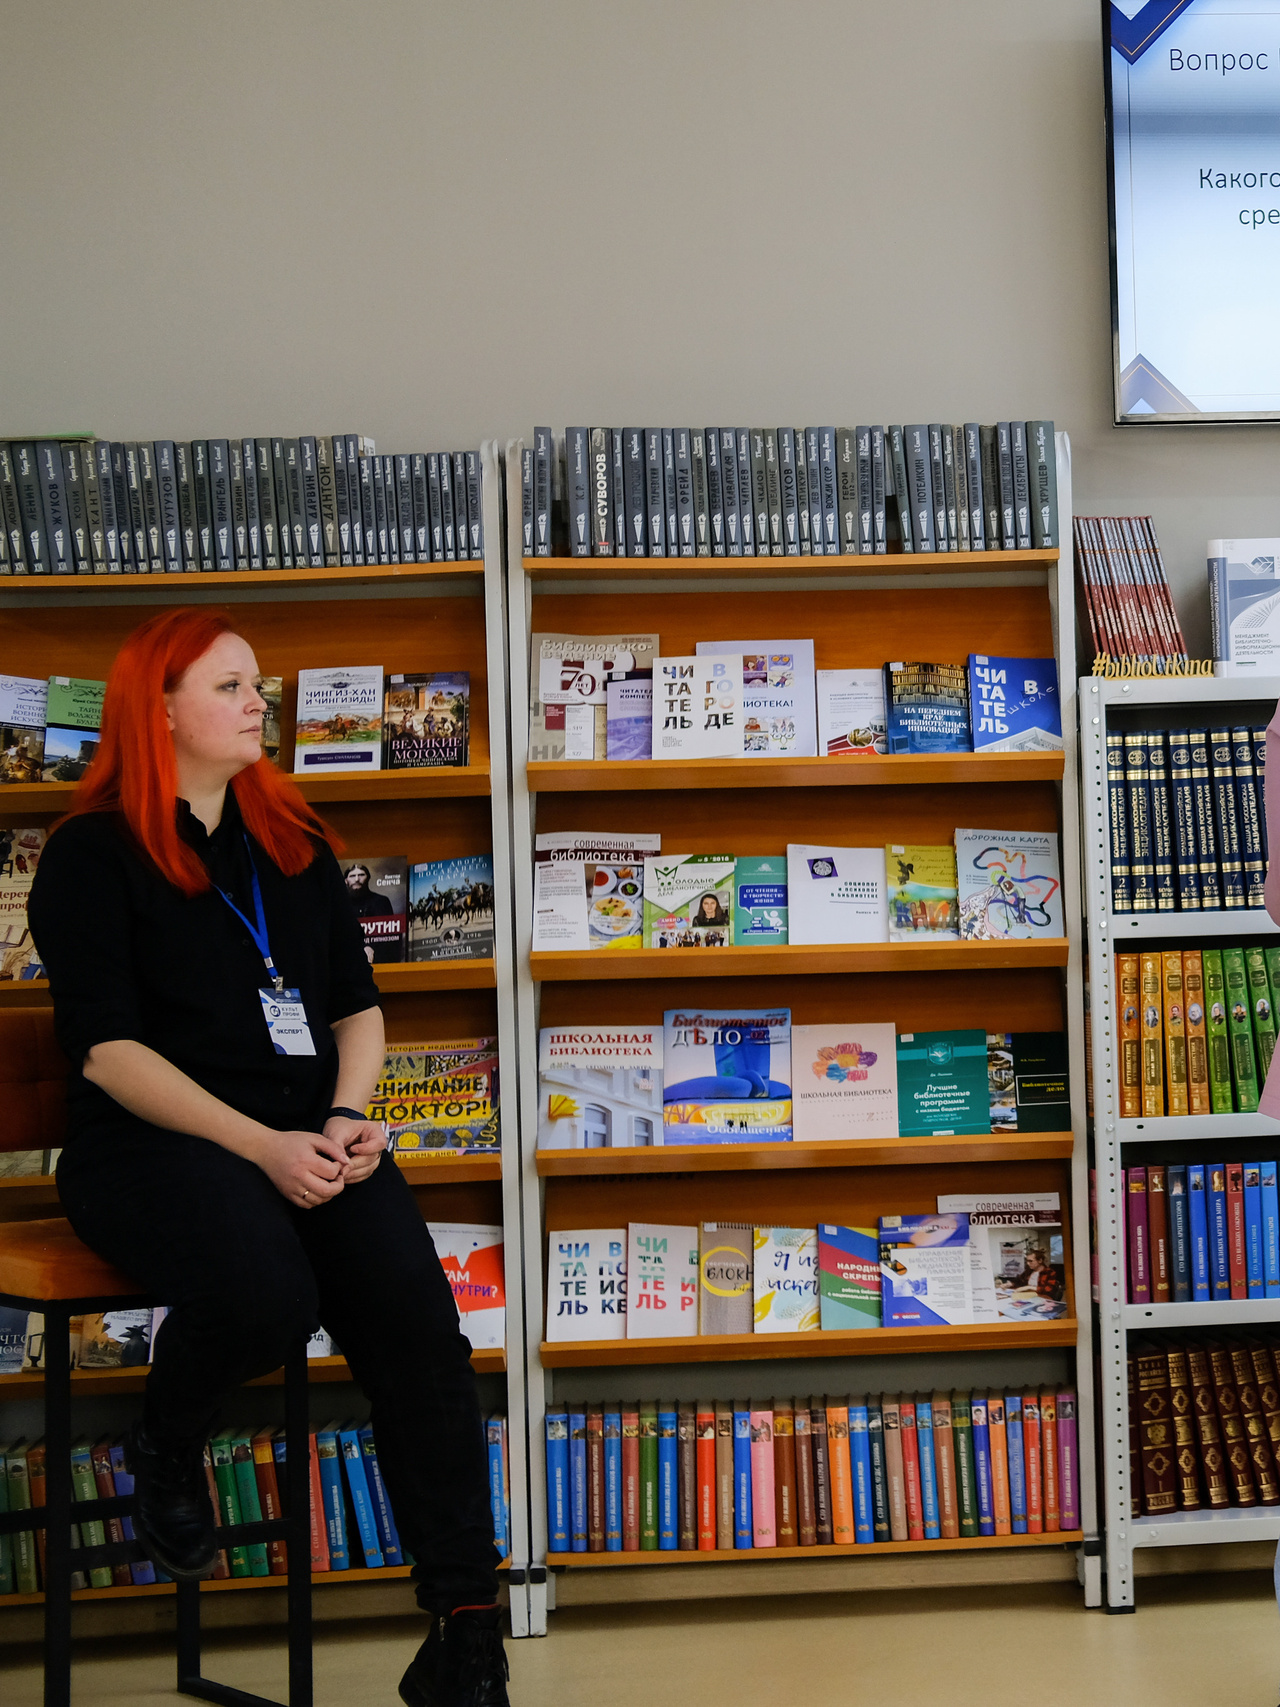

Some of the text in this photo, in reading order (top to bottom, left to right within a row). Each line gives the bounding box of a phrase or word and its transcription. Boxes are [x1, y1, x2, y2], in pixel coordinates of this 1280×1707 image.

[1170, 49, 1268, 75] Вопрос
[596, 454, 608, 516] СУВОРОВ
[916, 459, 926, 503] ПОТЕМКИН
[1016, 455, 1026, 501] ДЕКАБРИСТЫ
[1039, 465, 1049, 503] ХРУЩЕВ
[320, 466, 333, 520] ДАНТОН
[784, 469, 794, 508] ШУХОВ
[162, 476, 174, 525] КУТУЗОВ
[216, 478, 227, 522] ВРАНГЕЛЬ
[235, 486, 243, 521] БУЛАВИН
[306, 475, 317, 518] ДАРВИН
[826, 486, 834, 509] ВОЖДИ
[48, 484, 62, 525] ЖУКОВ
[89, 489, 99, 525] КАНТ
[541, 640, 653, 651] Библиотеко-
[542, 651, 616, 661] ведение
[662, 665, 694, 679] ЧИ
[712, 663, 726, 677] В
[975, 667, 1006, 684] ЧИ
[560, 670, 596, 696] 70
[664, 682, 692, 695] ТА
[706, 679, 733, 694] ГО
[1024, 680, 1038, 695] В
[305, 688, 376, 697] ЧИНГИЗ-ХАН
[978, 684, 1005, 700] ТА
[315, 696, 376, 704] ЧИНГИЗИДЫ
[665, 699, 692, 713] ТЕ
[705, 696, 735, 710] РО
[918, 708, 961, 716] ПЕРЕДНЕМ
[979, 701, 1006, 717] ТЕ
[662, 715, 693, 730] ЛЬ
[704, 713, 734, 730] ДЕ
[900, 719, 967, 729] БИБЛИОТЕЧНЫХ
[978, 718, 1009, 734] ЛЬ
[908, 726, 960, 734] ИННОВАЦИЙ
[392, 738, 462, 749] ВЕЛИКИЕ
[395, 749, 458, 760] МОГОЛЫ
[574, 839, 635, 848] современная
[452, 857, 484, 868] ДВОРЕ
[550, 850, 635, 862] библиотека
[418, 863, 488, 878] ПОСЛЕДНЕГО
[438, 872, 466, 881] ЦАРЯ
[1253, 873, 1260, 882] 8
[1119, 878, 1125, 888] 2
[1140, 877, 1146, 887] 3
[1164, 877, 1170, 887] 4
[1188, 876, 1194, 885] 5
[1208, 875, 1214, 884] 6
[1232, 874, 1238, 883] 7
[672, 1014, 787, 1027] Библиотечное
[550, 1033, 652, 1044] ШКОЛЬНАЯ
[424, 1043, 474, 1051] медицины
[550, 1047, 652, 1056] БИБЛИОТЕКА
[801, 1088, 892, 1099] ШКОЛЬНАЯ БИБЛИОТЕКА
[914, 1090, 971, 1100] библиотечные
[926, 1084, 958, 1092] Лучшие
[920, 1098, 965, 1107] программы
[369, 1100, 487, 1120] ДОКТОР!
[975, 1201, 1035, 1212] современная
[559, 1242, 590, 1258] ЧИ
[609, 1242, 622, 1257] В
[636, 1237, 668, 1253] ЧИ
[560, 1262, 587, 1277] ТА
[560, 1281, 586, 1296] ТЕ
[638, 1275, 665, 1290] ТЕ
[557, 1300, 588, 1316] ЛЬ
[636, 1294, 667, 1309] ЛЬ
